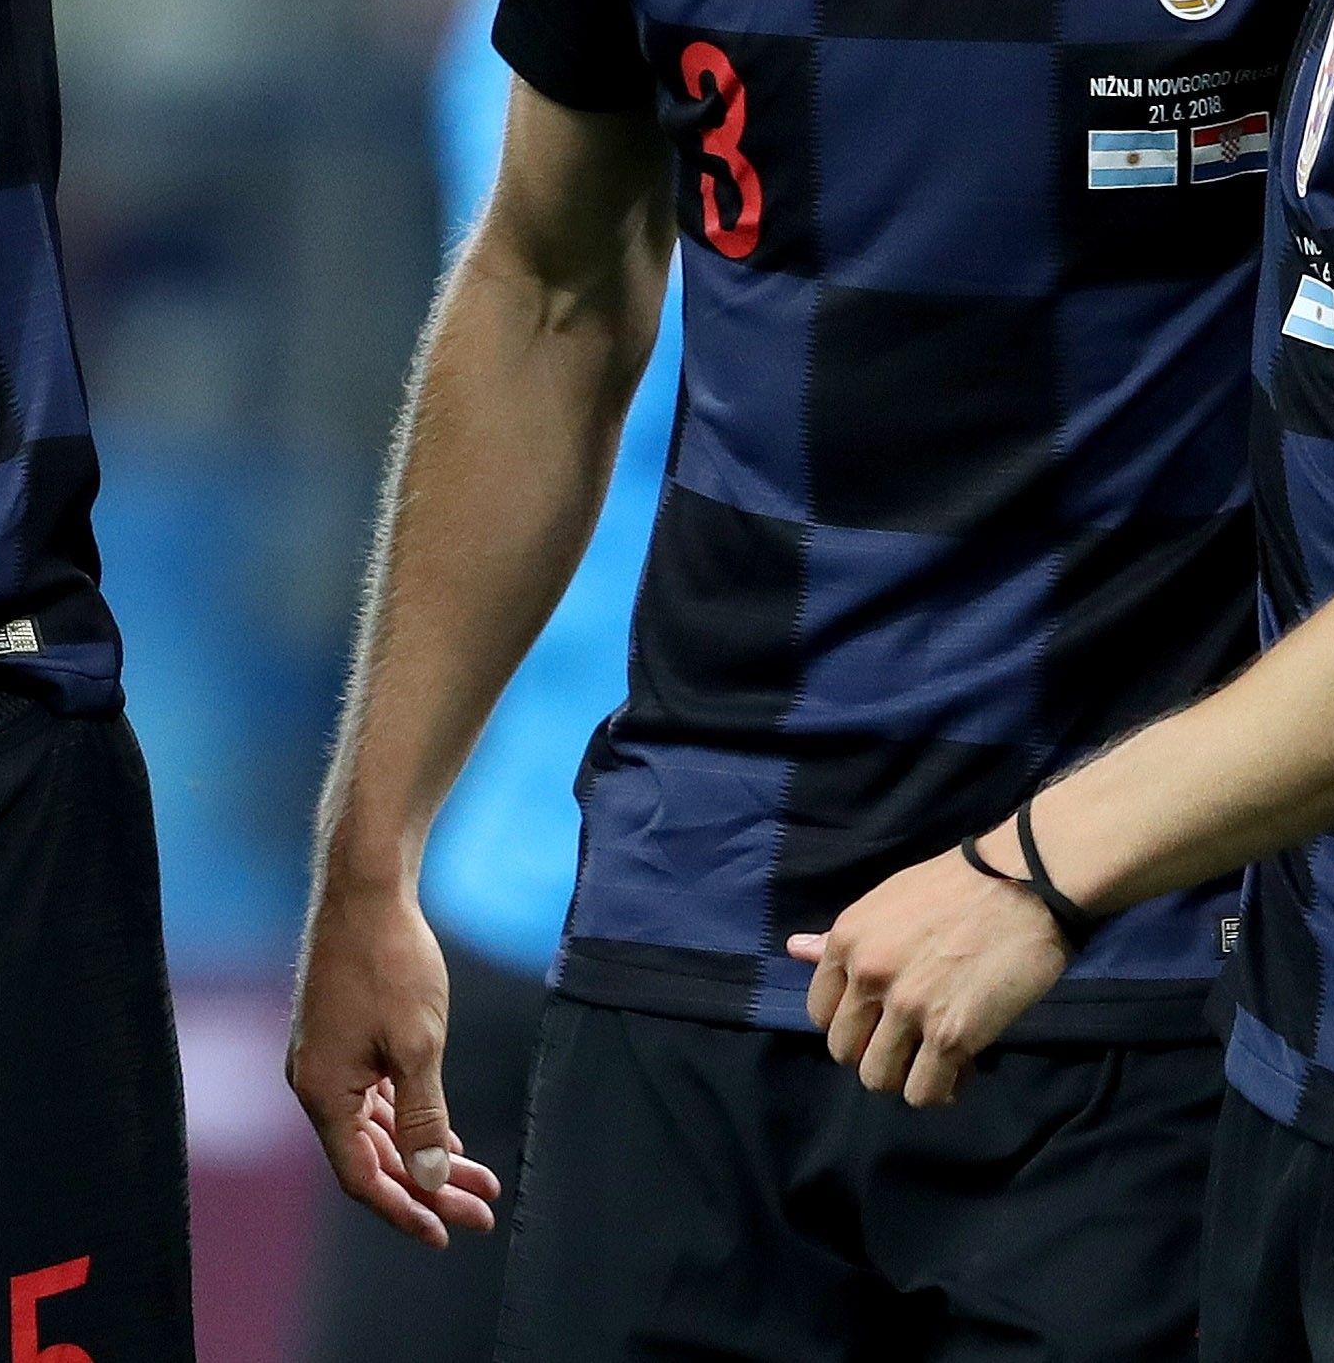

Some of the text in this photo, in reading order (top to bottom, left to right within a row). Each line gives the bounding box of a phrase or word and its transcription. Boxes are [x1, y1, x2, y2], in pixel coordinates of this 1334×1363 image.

[1090, 75, 1143, 98] NIŽNJI
[1147, 70, 1232, 98] NOVGOROD
[1188, 94, 1225, 121] 2018.
[680, 40, 763, 260] 3
